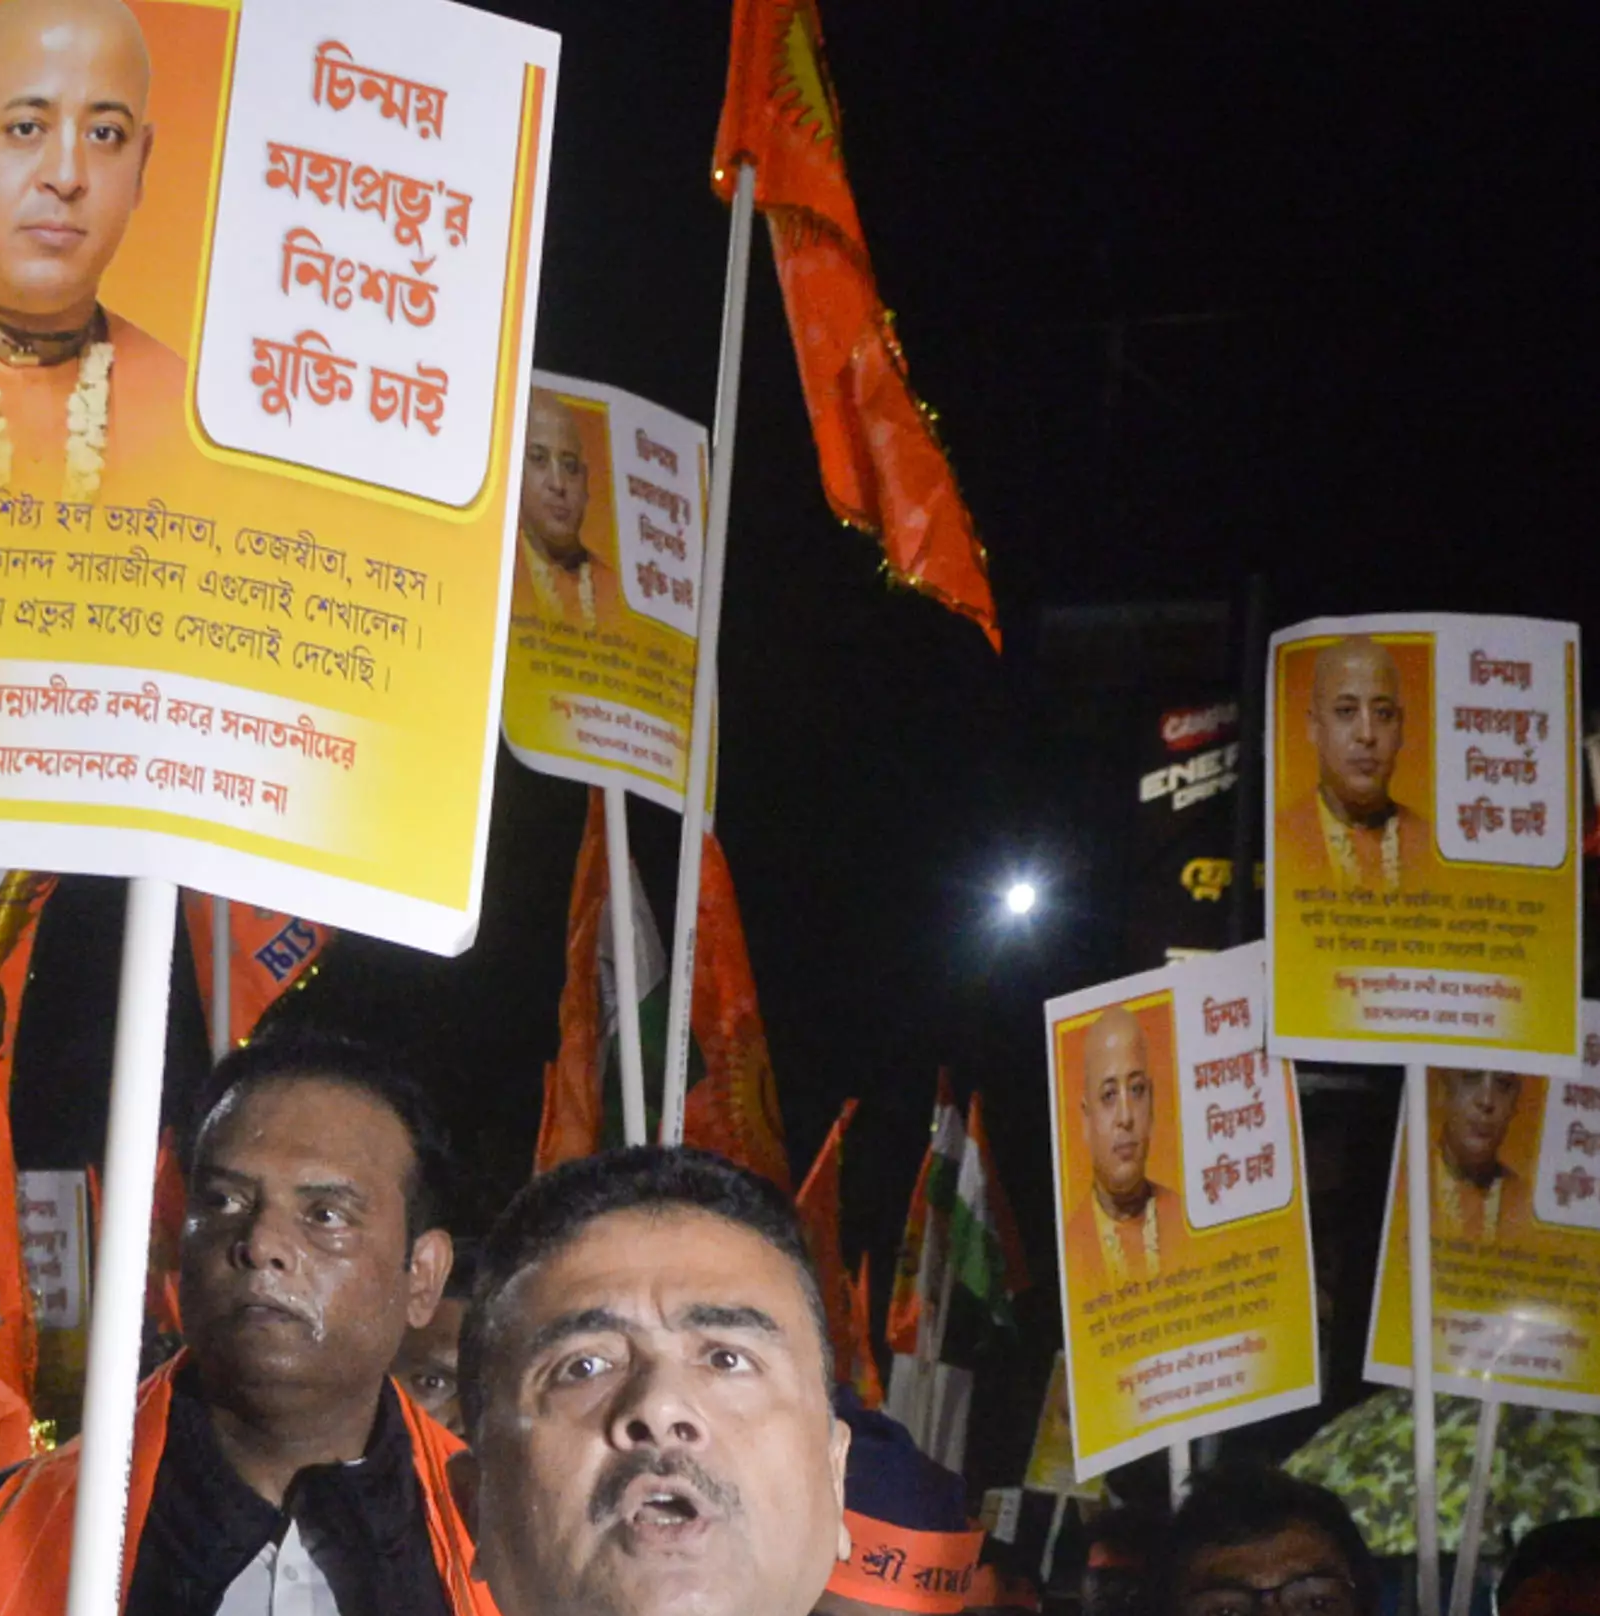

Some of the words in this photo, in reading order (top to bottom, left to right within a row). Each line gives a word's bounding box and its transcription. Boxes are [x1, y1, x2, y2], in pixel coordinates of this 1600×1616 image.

[313, 40, 448, 140] চিন্ময়
[265, 140, 473, 257] মহাপ্রভু'র
[282, 227, 439, 327] নিঃশর্ত
[251, 329, 357, 427] মুক্তি
[368, 362, 448, 436] চাই
[55, 501, 94, 532] হল
[67, 545, 187, 592] সারাজীবন
[198, 568, 295, 619] এগুলোই
[15, 599, 77, 637] প্রভুর
[87, 602, 164, 638] মধ্যেও
[174, 613, 283, 666] সেগুলোই
[1469, 649, 1533, 691] চিন্ময়
[106, 681, 161, 724] বন্দী
[166, 698, 214, 737] করে
[221, 708, 357, 771] সনাতনীদের
[145, 757, 205, 795] রোখা
[212, 768, 255, 808] যায়
[261, 780, 289, 815] না
[1457, 796, 1505, 843] মুক্তি
[1510, 802, 1547, 839] চাই
[862, 1544, 907, 1584] শ্রী
